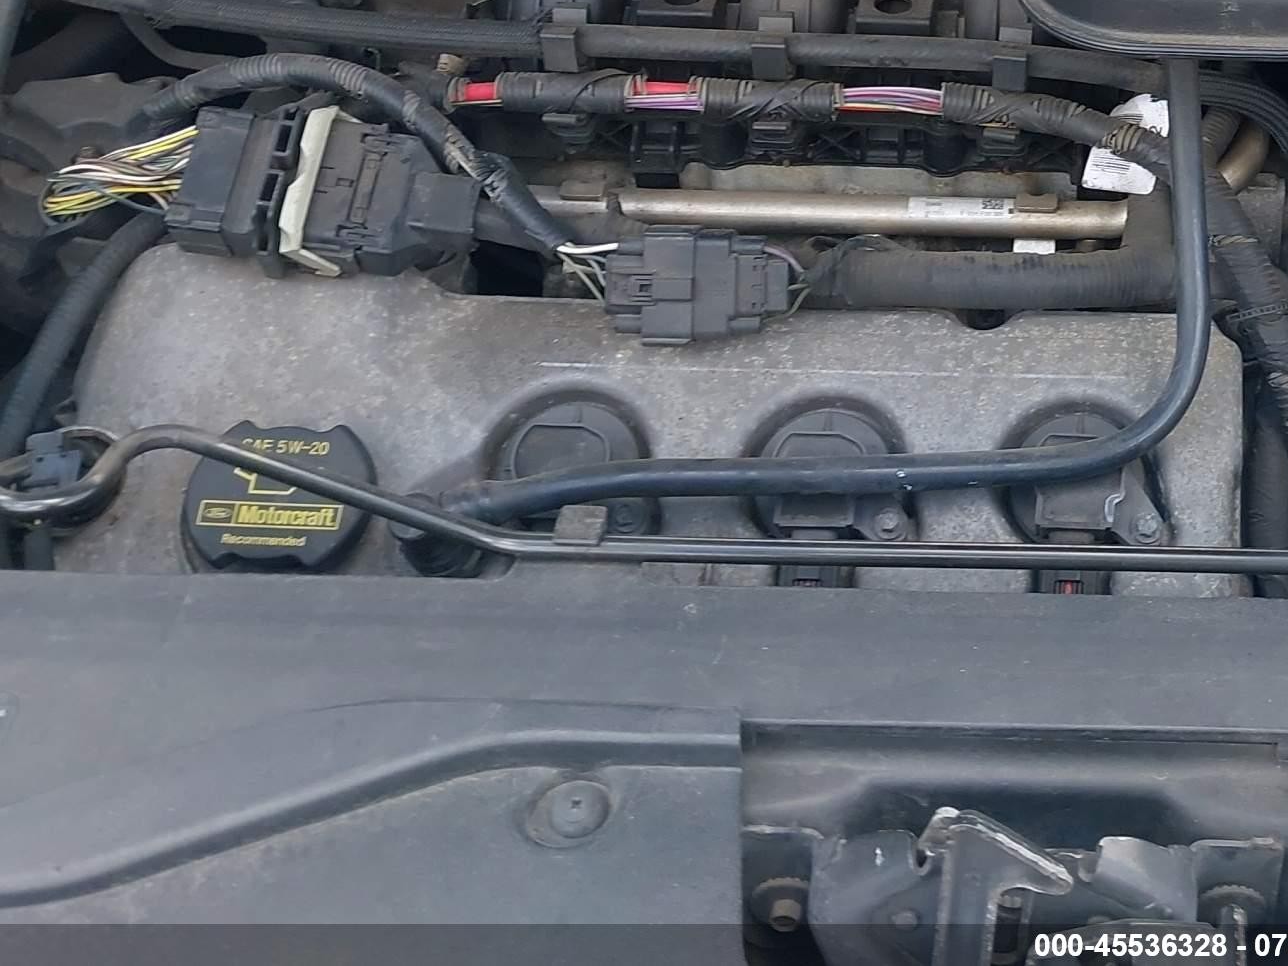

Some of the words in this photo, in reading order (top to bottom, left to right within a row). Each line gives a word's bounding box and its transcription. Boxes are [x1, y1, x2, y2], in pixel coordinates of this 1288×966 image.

[276, 439, 330, 456] 5W-20
[237, 504, 336, 526] Motorcraft
[220, 533, 308, 547] Recommended
